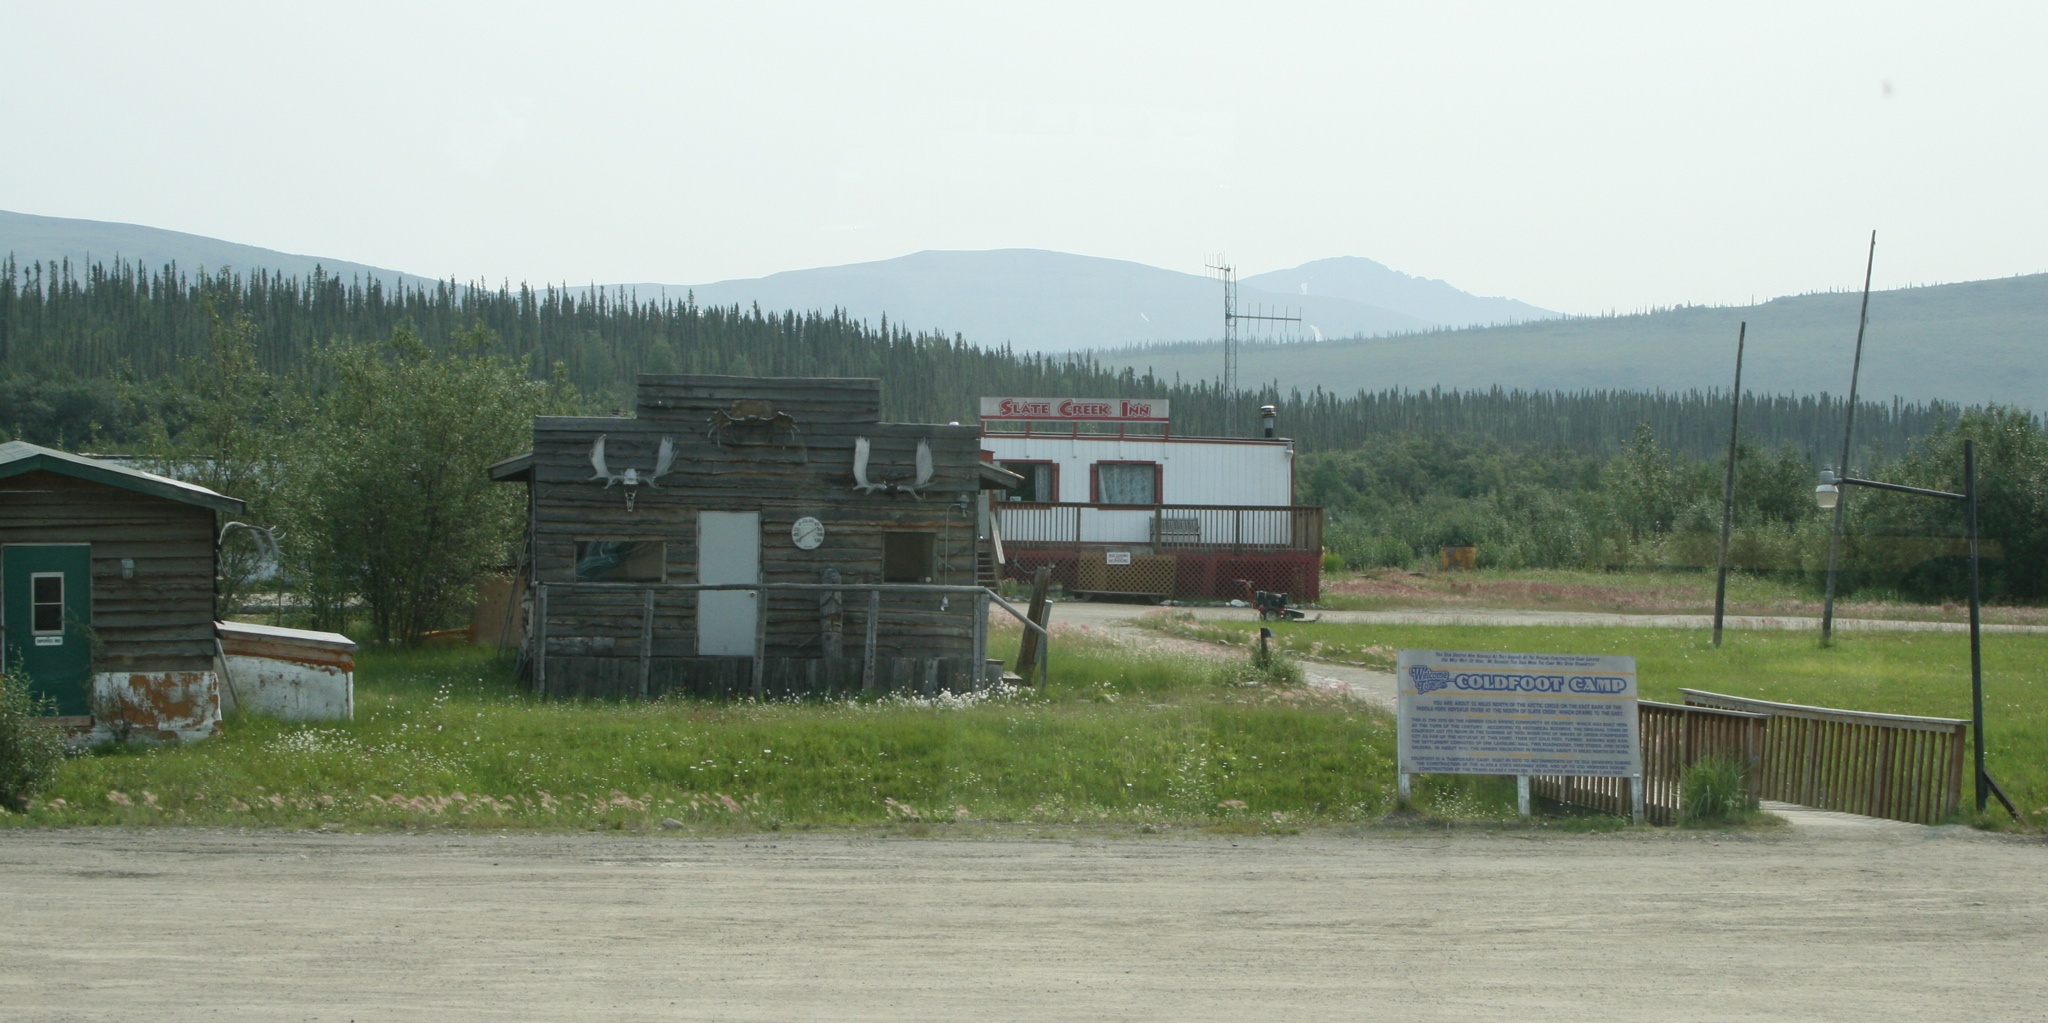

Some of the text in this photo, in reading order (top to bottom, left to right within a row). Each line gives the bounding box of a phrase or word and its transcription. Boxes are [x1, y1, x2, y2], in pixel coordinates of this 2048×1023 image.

[1000, 399, 1150, 418] SLATE CREEK INN
[1410, 665, 1449, 681] Welcome
[1455, 674, 1627, 693] COLDFOOT CAMP
